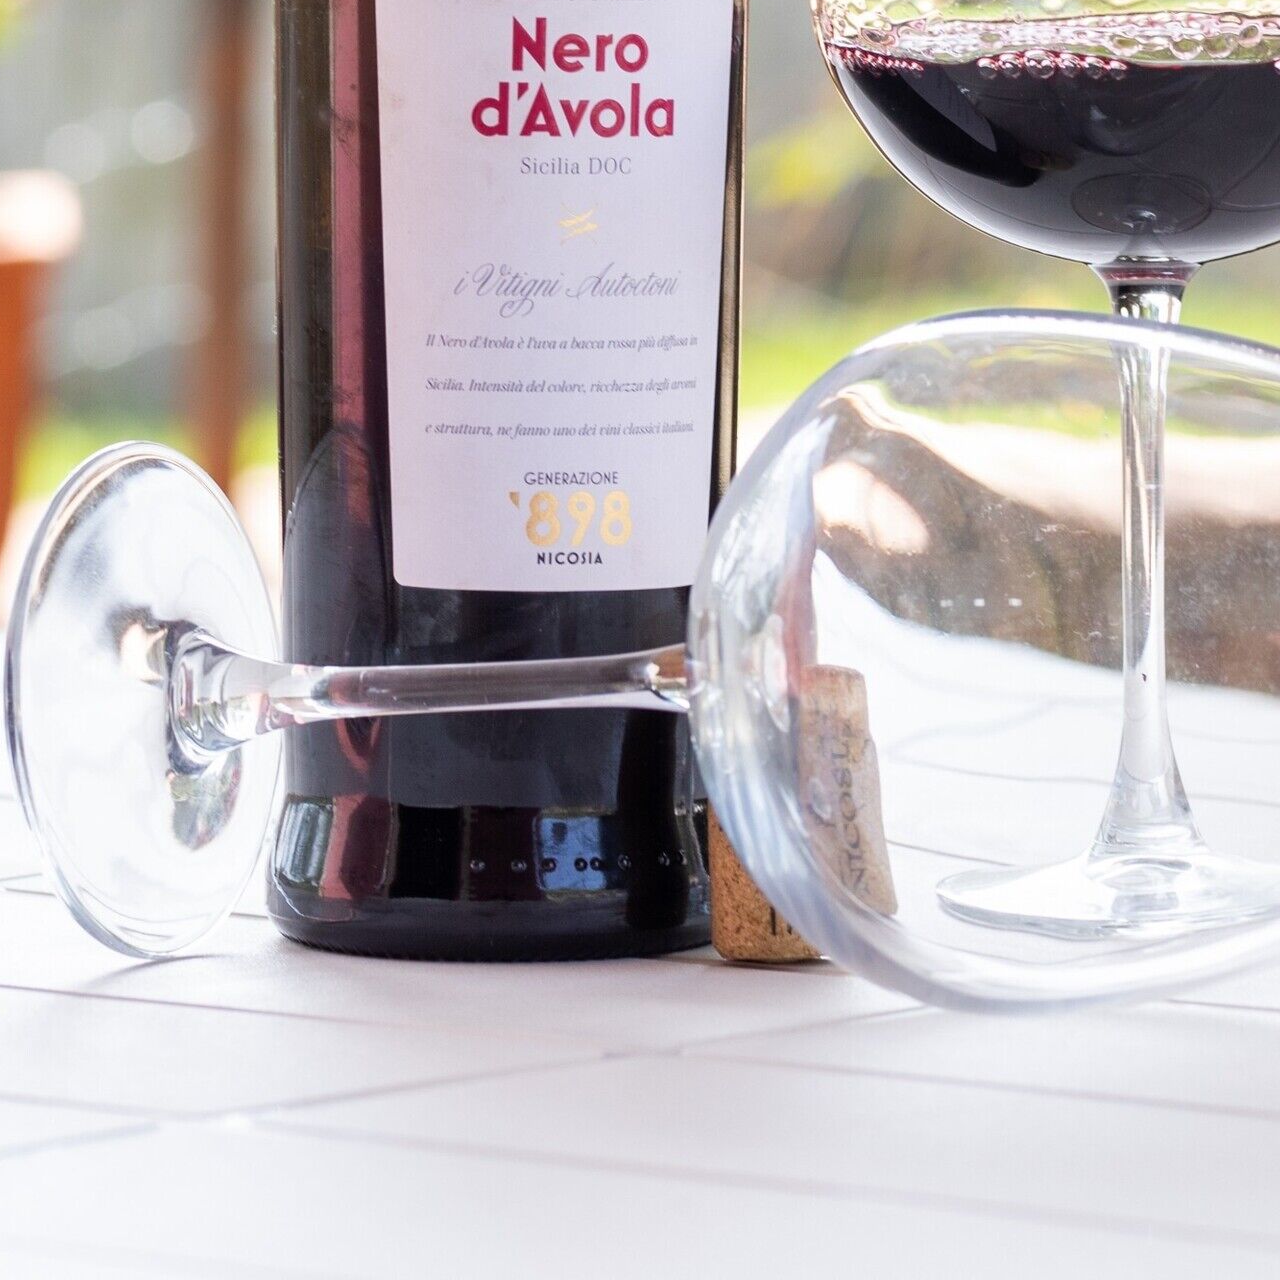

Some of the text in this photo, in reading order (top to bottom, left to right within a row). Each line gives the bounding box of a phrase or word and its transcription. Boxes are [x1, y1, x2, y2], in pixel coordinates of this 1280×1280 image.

[512, 16, 649, 73] Nero
[471, 81, 675, 138] d'Avola
[520, 157, 632, 175] Sicilia DOC
[472, 263, 564, 319] Vitigni
[566, 262, 682, 300] Autoctoni
[425, 334, 436, 347] Il
[438, 334, 466, 348] Nero
[469, 335, 515, 350] d'Avola
[527, 336, 557, 350] l'uva
[559, 340, 568, 350] a
[570, 336, 605, 350] bacca
[607, 339, 637, 350] rossa
[637, 335, 656, 352] più
[425, 377, 465, 392] Sicilia.
[469, 378, 524, 393] Intensità
[526, 379, 546, 393] del
[547, 380, 587, 394] colore,
[590, 379, 644, 393] ricchezza
[645, 378, 669, 396] degli
[424, 424, 433, 434] e
[434, 423, 494, 437] struttura,
[497, 426, 512, 437] ne
[510, 423, 550, 440] fanno
[553, 426, 577, 437] uno
[578, 423, 597, 436] dei
[599, 424, 621, 436] vini
[623, 422, 661, 436] classici
[523, 471, 619, 486] GENERAZIONE
[537, 551, 603, 565] NICOSIA
